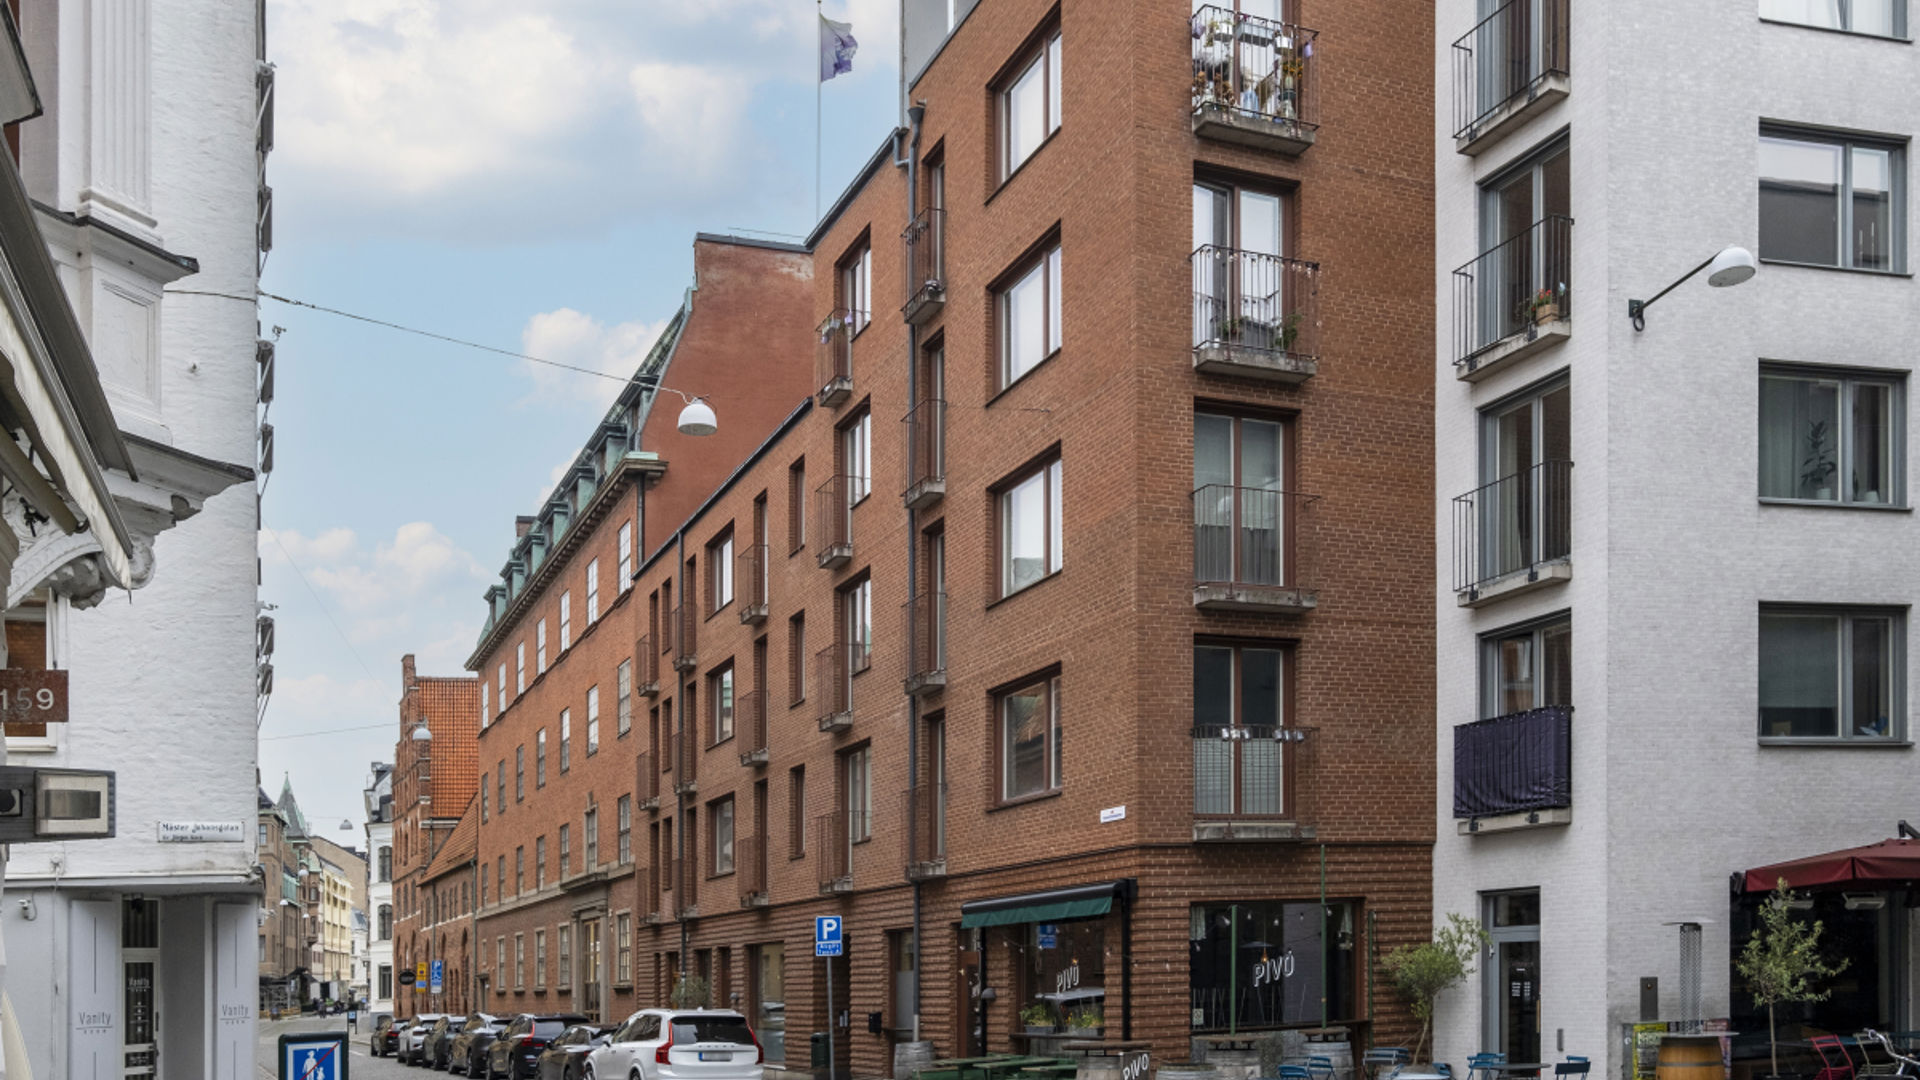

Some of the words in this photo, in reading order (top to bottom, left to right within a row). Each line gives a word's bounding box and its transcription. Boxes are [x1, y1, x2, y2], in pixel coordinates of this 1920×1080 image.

[823, 919, 837, 939] P
[222, 1003, 249, 1017] Vanity
[79, 1012, 112, 1025] Vanity
